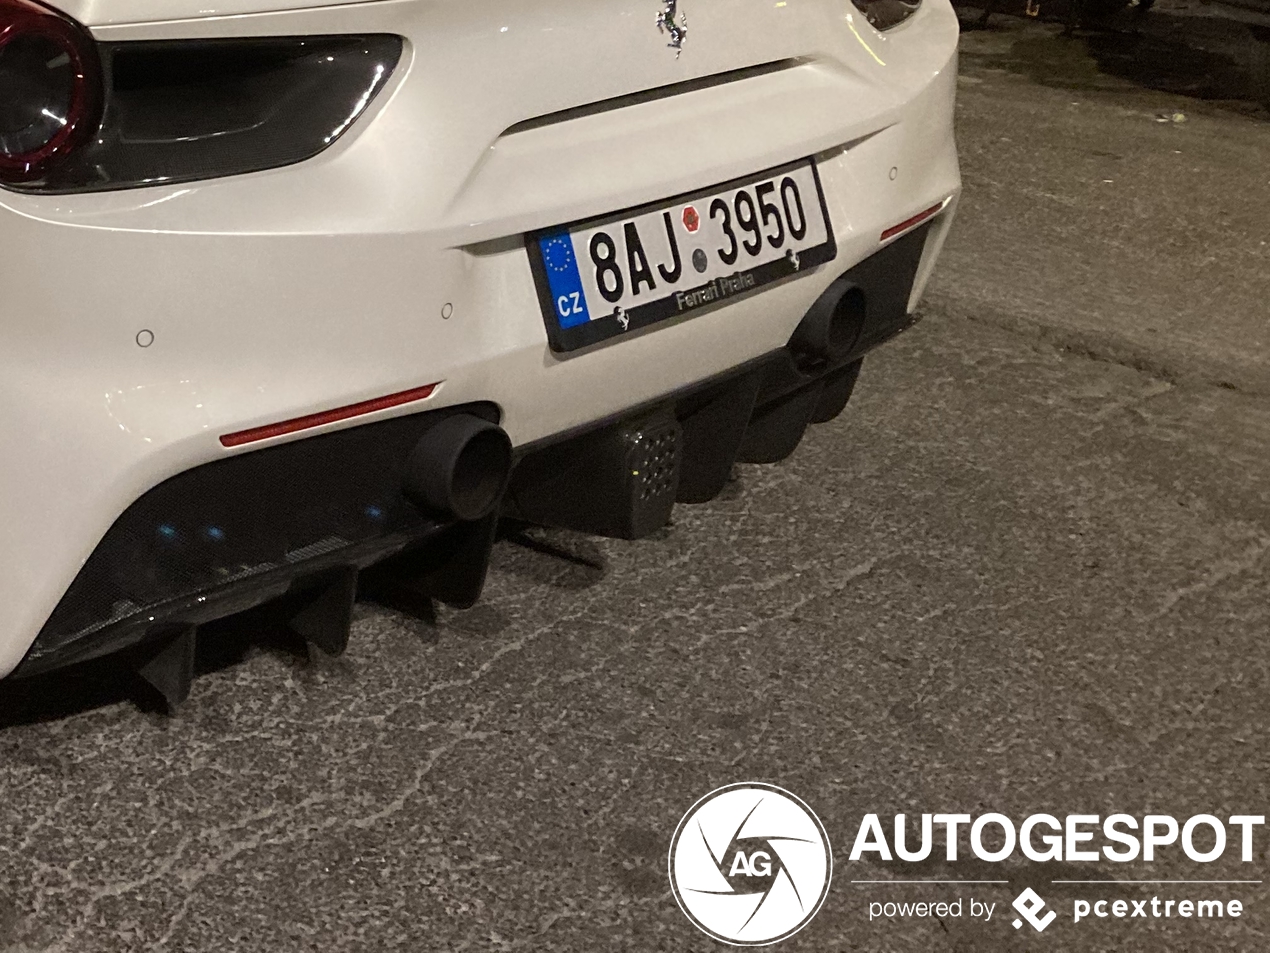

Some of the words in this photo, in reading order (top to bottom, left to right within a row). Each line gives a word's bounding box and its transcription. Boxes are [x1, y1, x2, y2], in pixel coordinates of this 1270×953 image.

[557, 291, 583, 318] CZ
[589, 212, 682, 303] 8AJ
[708, 176, 807, 266] 3950
[676, 279, 719, 311] Ferrari
[720, 271, 755, 299] Praha
